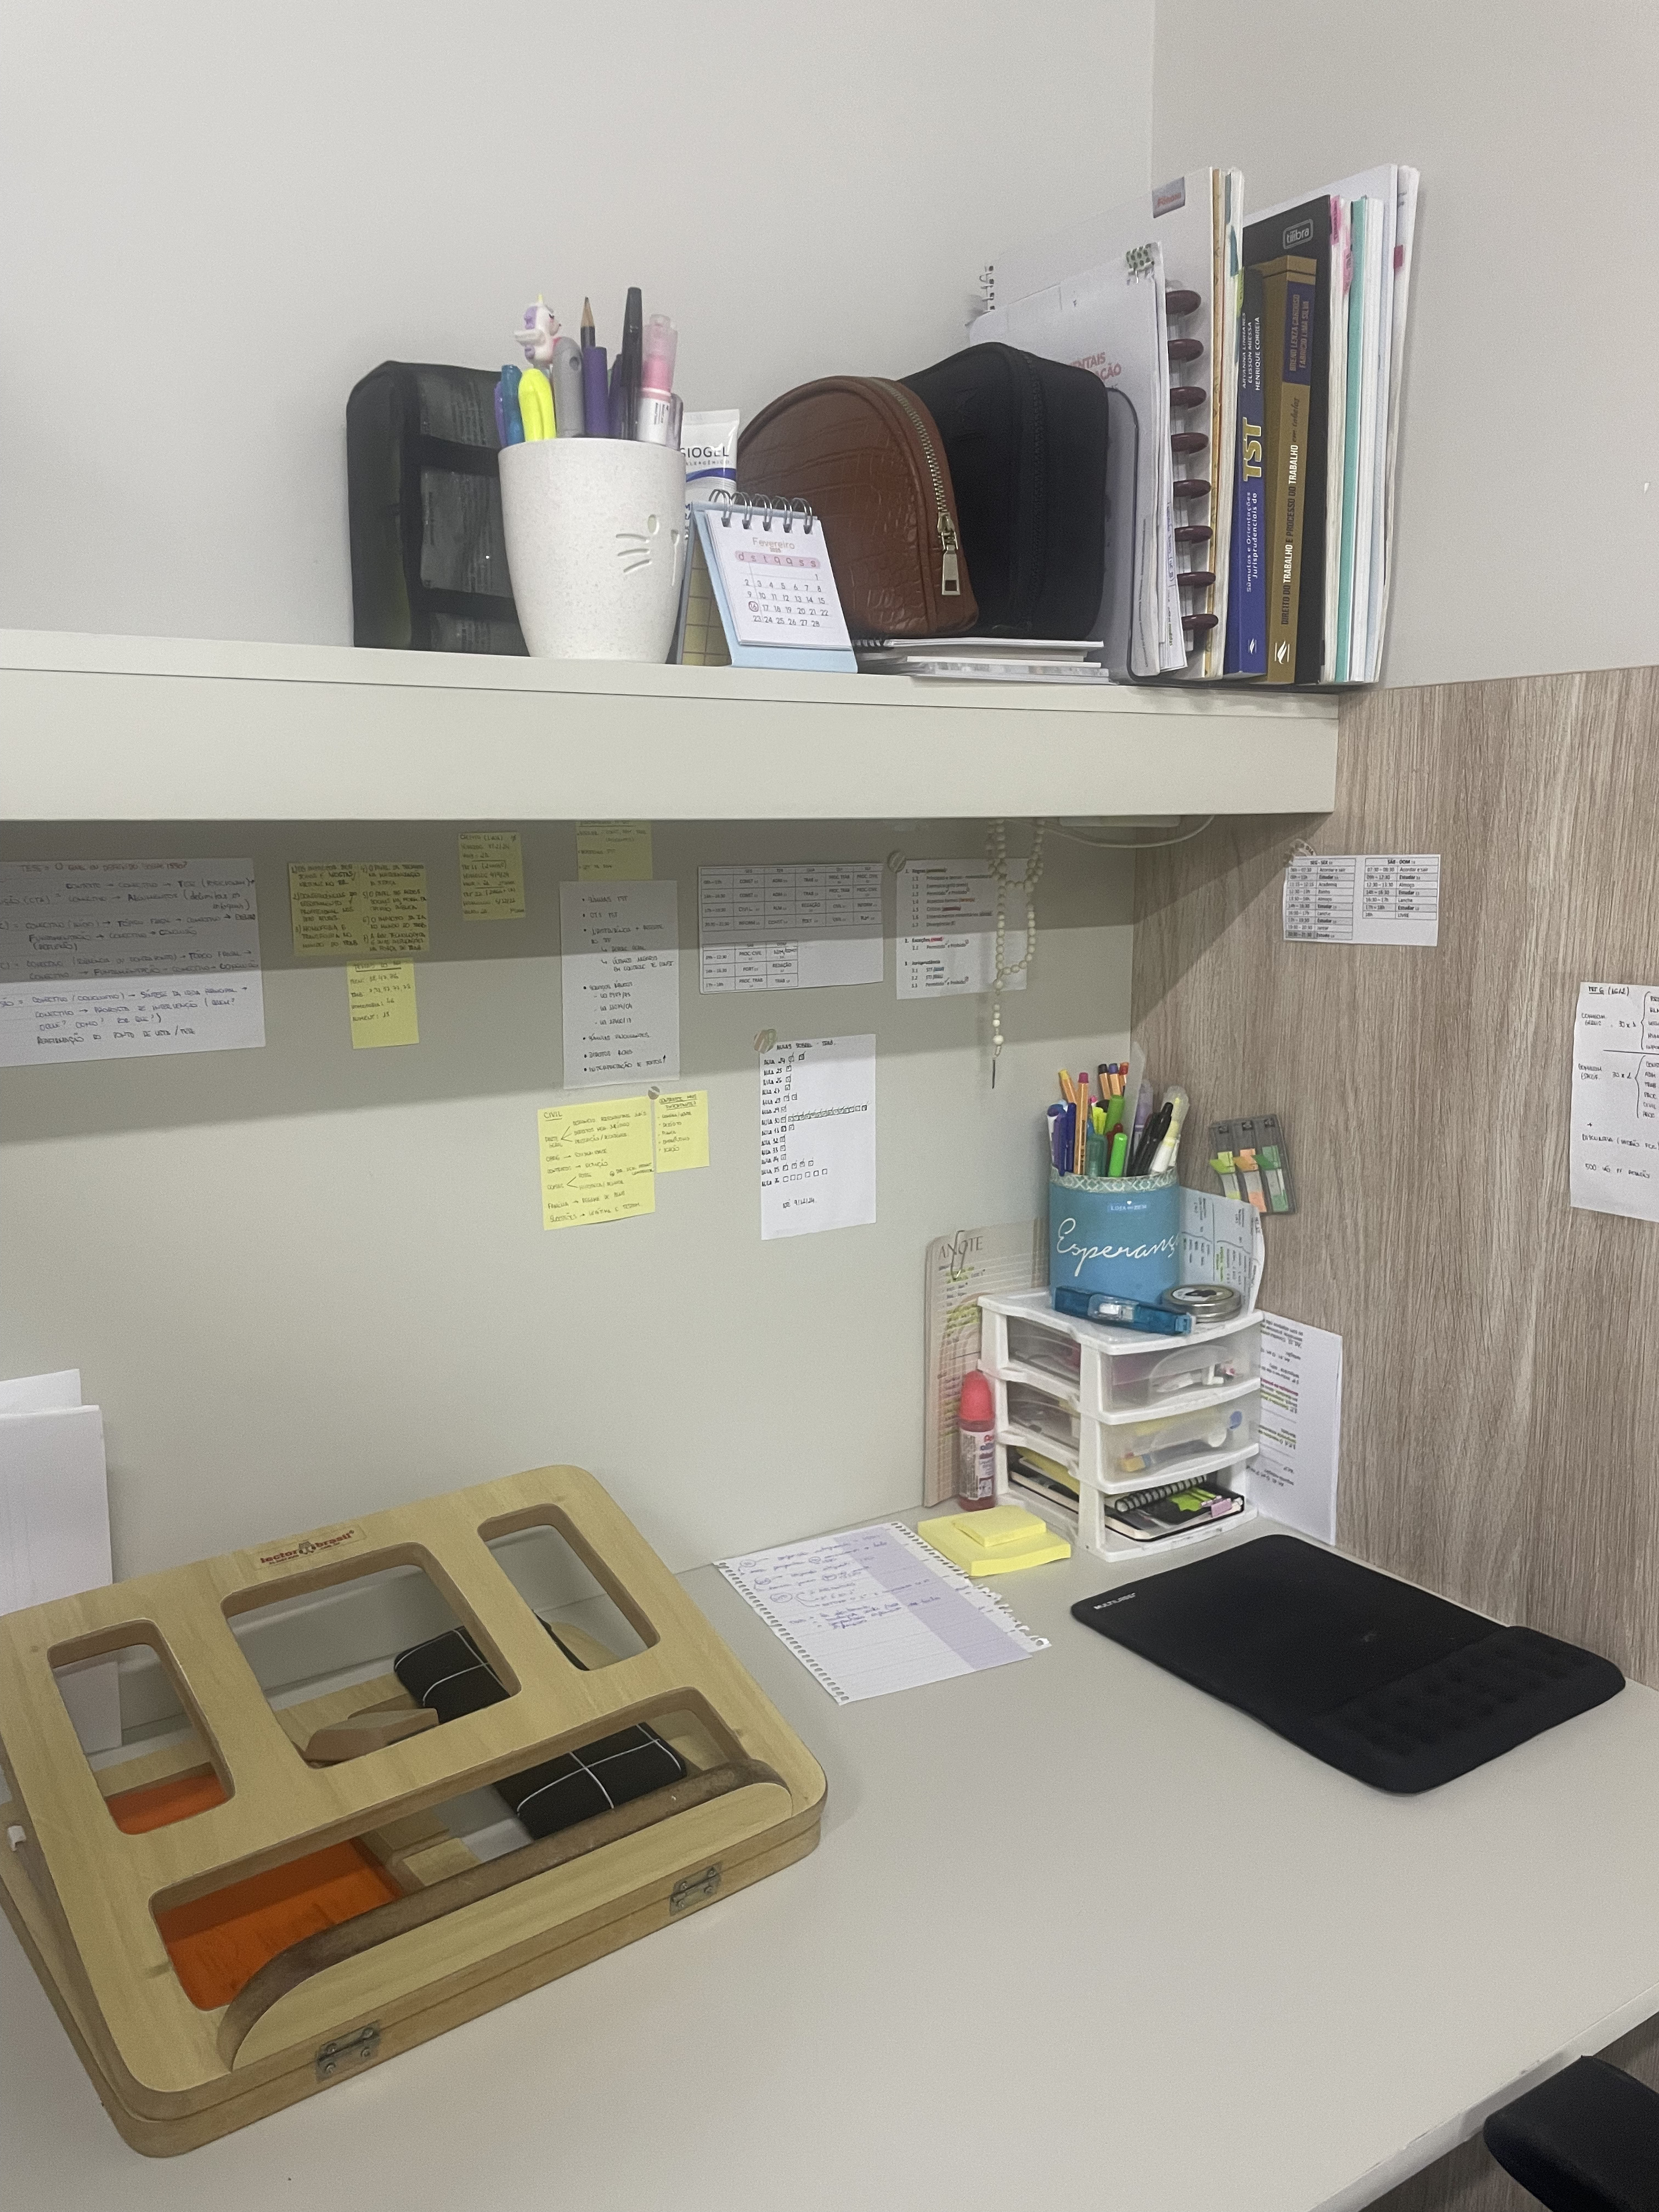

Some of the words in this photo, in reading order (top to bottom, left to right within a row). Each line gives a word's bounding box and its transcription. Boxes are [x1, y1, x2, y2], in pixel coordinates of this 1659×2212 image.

[1242, 416, 1262, 482] TST
[1289, 444, 1299, 484] TRABALHO
[1252, 493, 1257, 504] do
[1288, 486, 1296, 496] DO
[1286, 498, 1296, 538] PROCESSO
[752, 537, 795, 550] Fevereiro
[738, 552, 744, 561] d
[1283, 544, 1294, 584] TRABALHO
[1283, 585, 1291, 595] DO
[1281, 595, 1290, 625] DIREITO
[938, 1235, 984, 1260] ANOTE
[260, 1550, 297, 1564] lector
